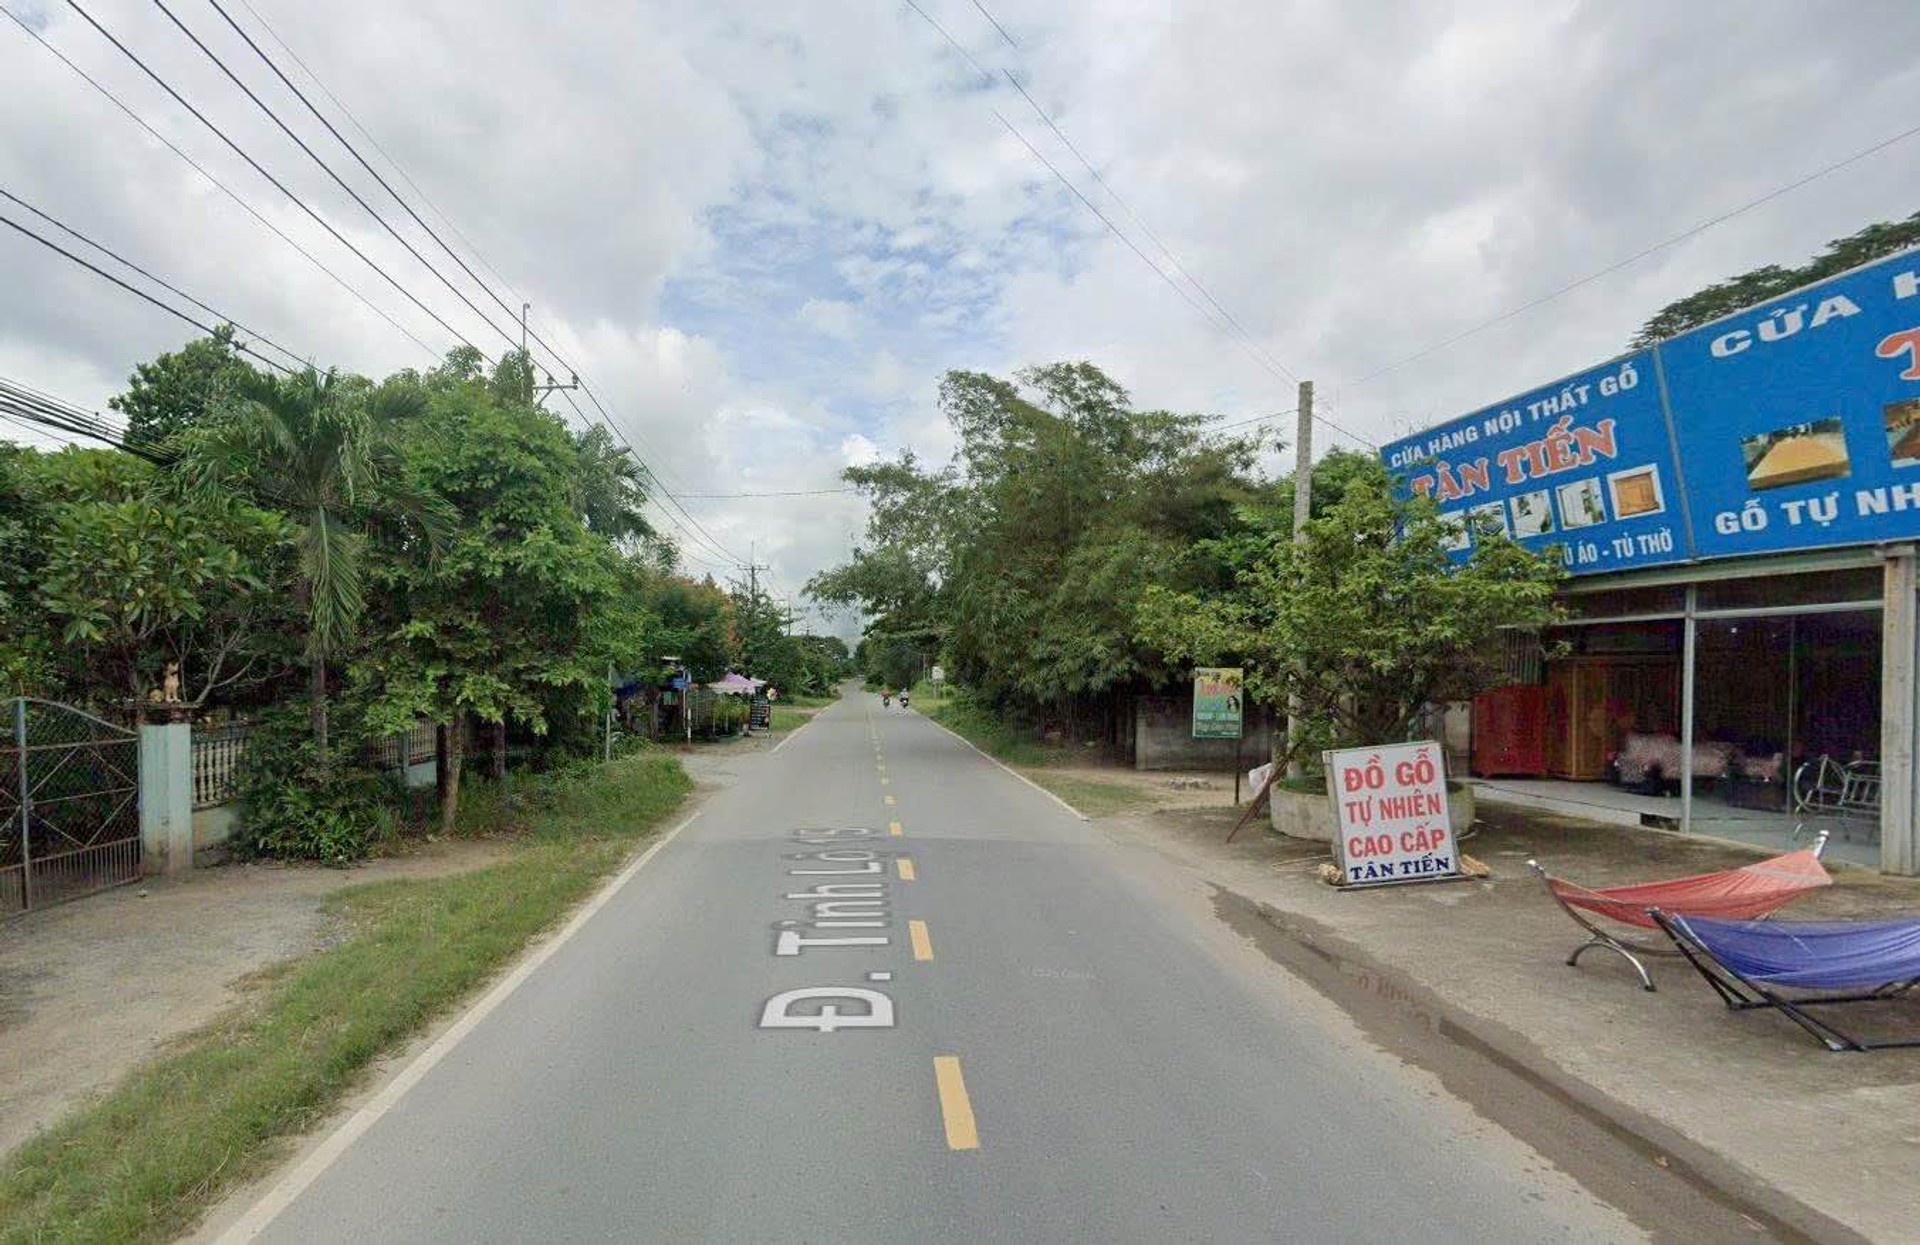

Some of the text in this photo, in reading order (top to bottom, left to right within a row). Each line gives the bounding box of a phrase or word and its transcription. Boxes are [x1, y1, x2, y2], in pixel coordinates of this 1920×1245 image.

[1712, 295, 1862, 357] CỬA
[1391, 361, 1639, 467] CỬA HÀNG NỘI THẤT GỖ
[1411, 415, 1617, 502] TÂN TIẾN
[1715, 482, 1920, 535] GỖ TỰ NH
[1578, 538, 1597, 564] ÁO
[1612, 531, 1635, 559] TỦ
[1637, 528, 1674, 554] THỜ
[1344, 747, 1434, 792] ĐỒ GỖ
[1345, 789, 1441, 827] TỰ NHIÊN
[1349, 821, 1445, 857] CAO CẤP
[1350, 852, 1450, 880] TÂN TIẾN
